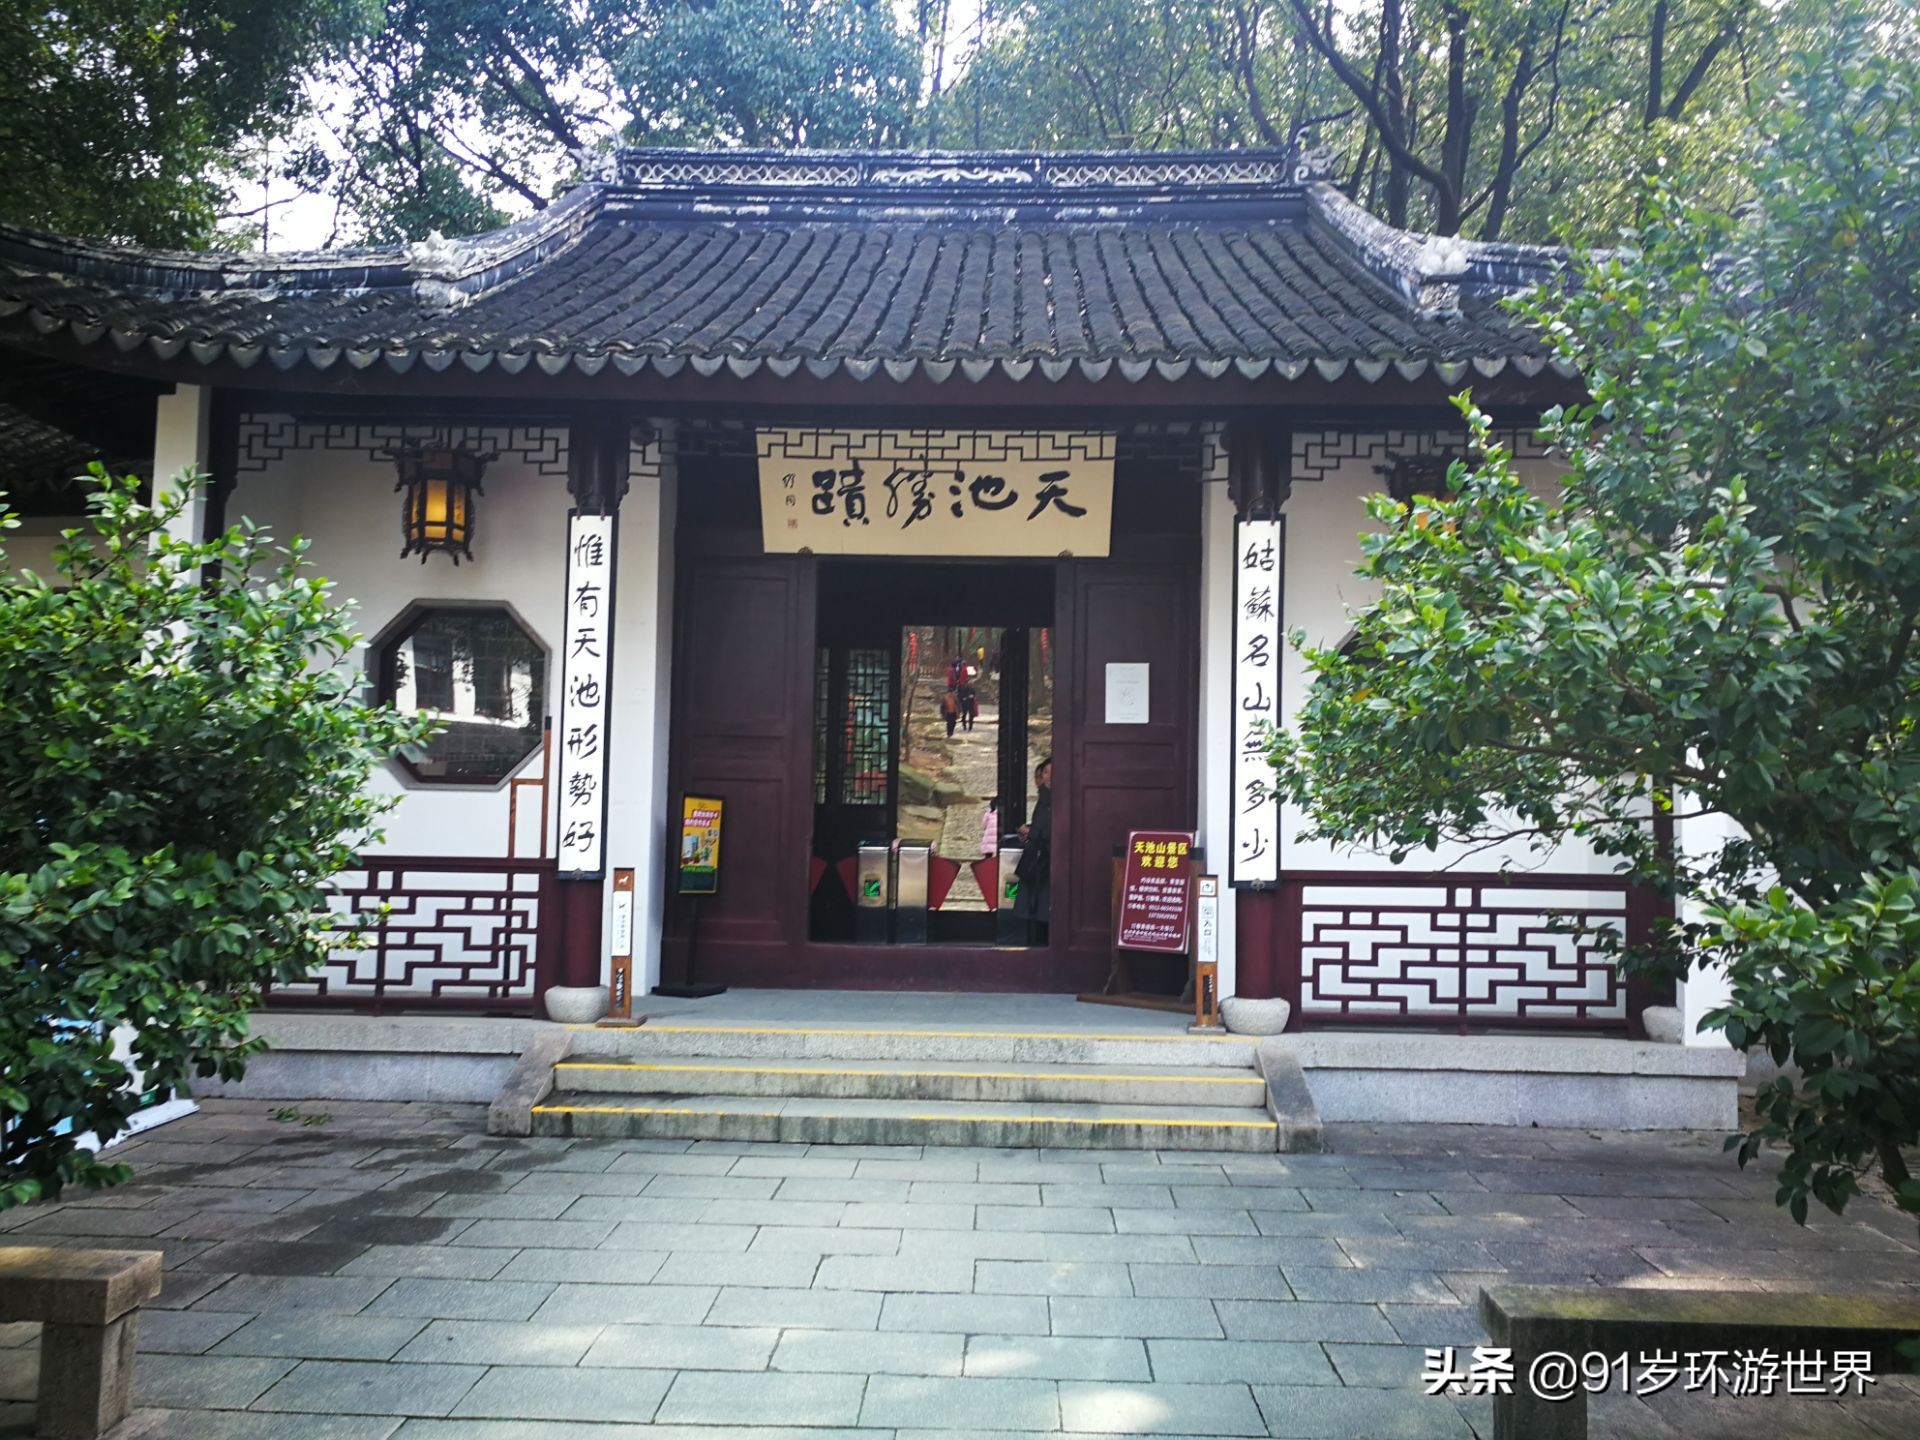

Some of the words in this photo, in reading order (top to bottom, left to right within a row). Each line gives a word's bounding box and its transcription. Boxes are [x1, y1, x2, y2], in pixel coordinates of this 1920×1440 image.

[1134, 840, 1189, 856] 天池山景区
[1140, 855, 1179, 869] 欢迎您
